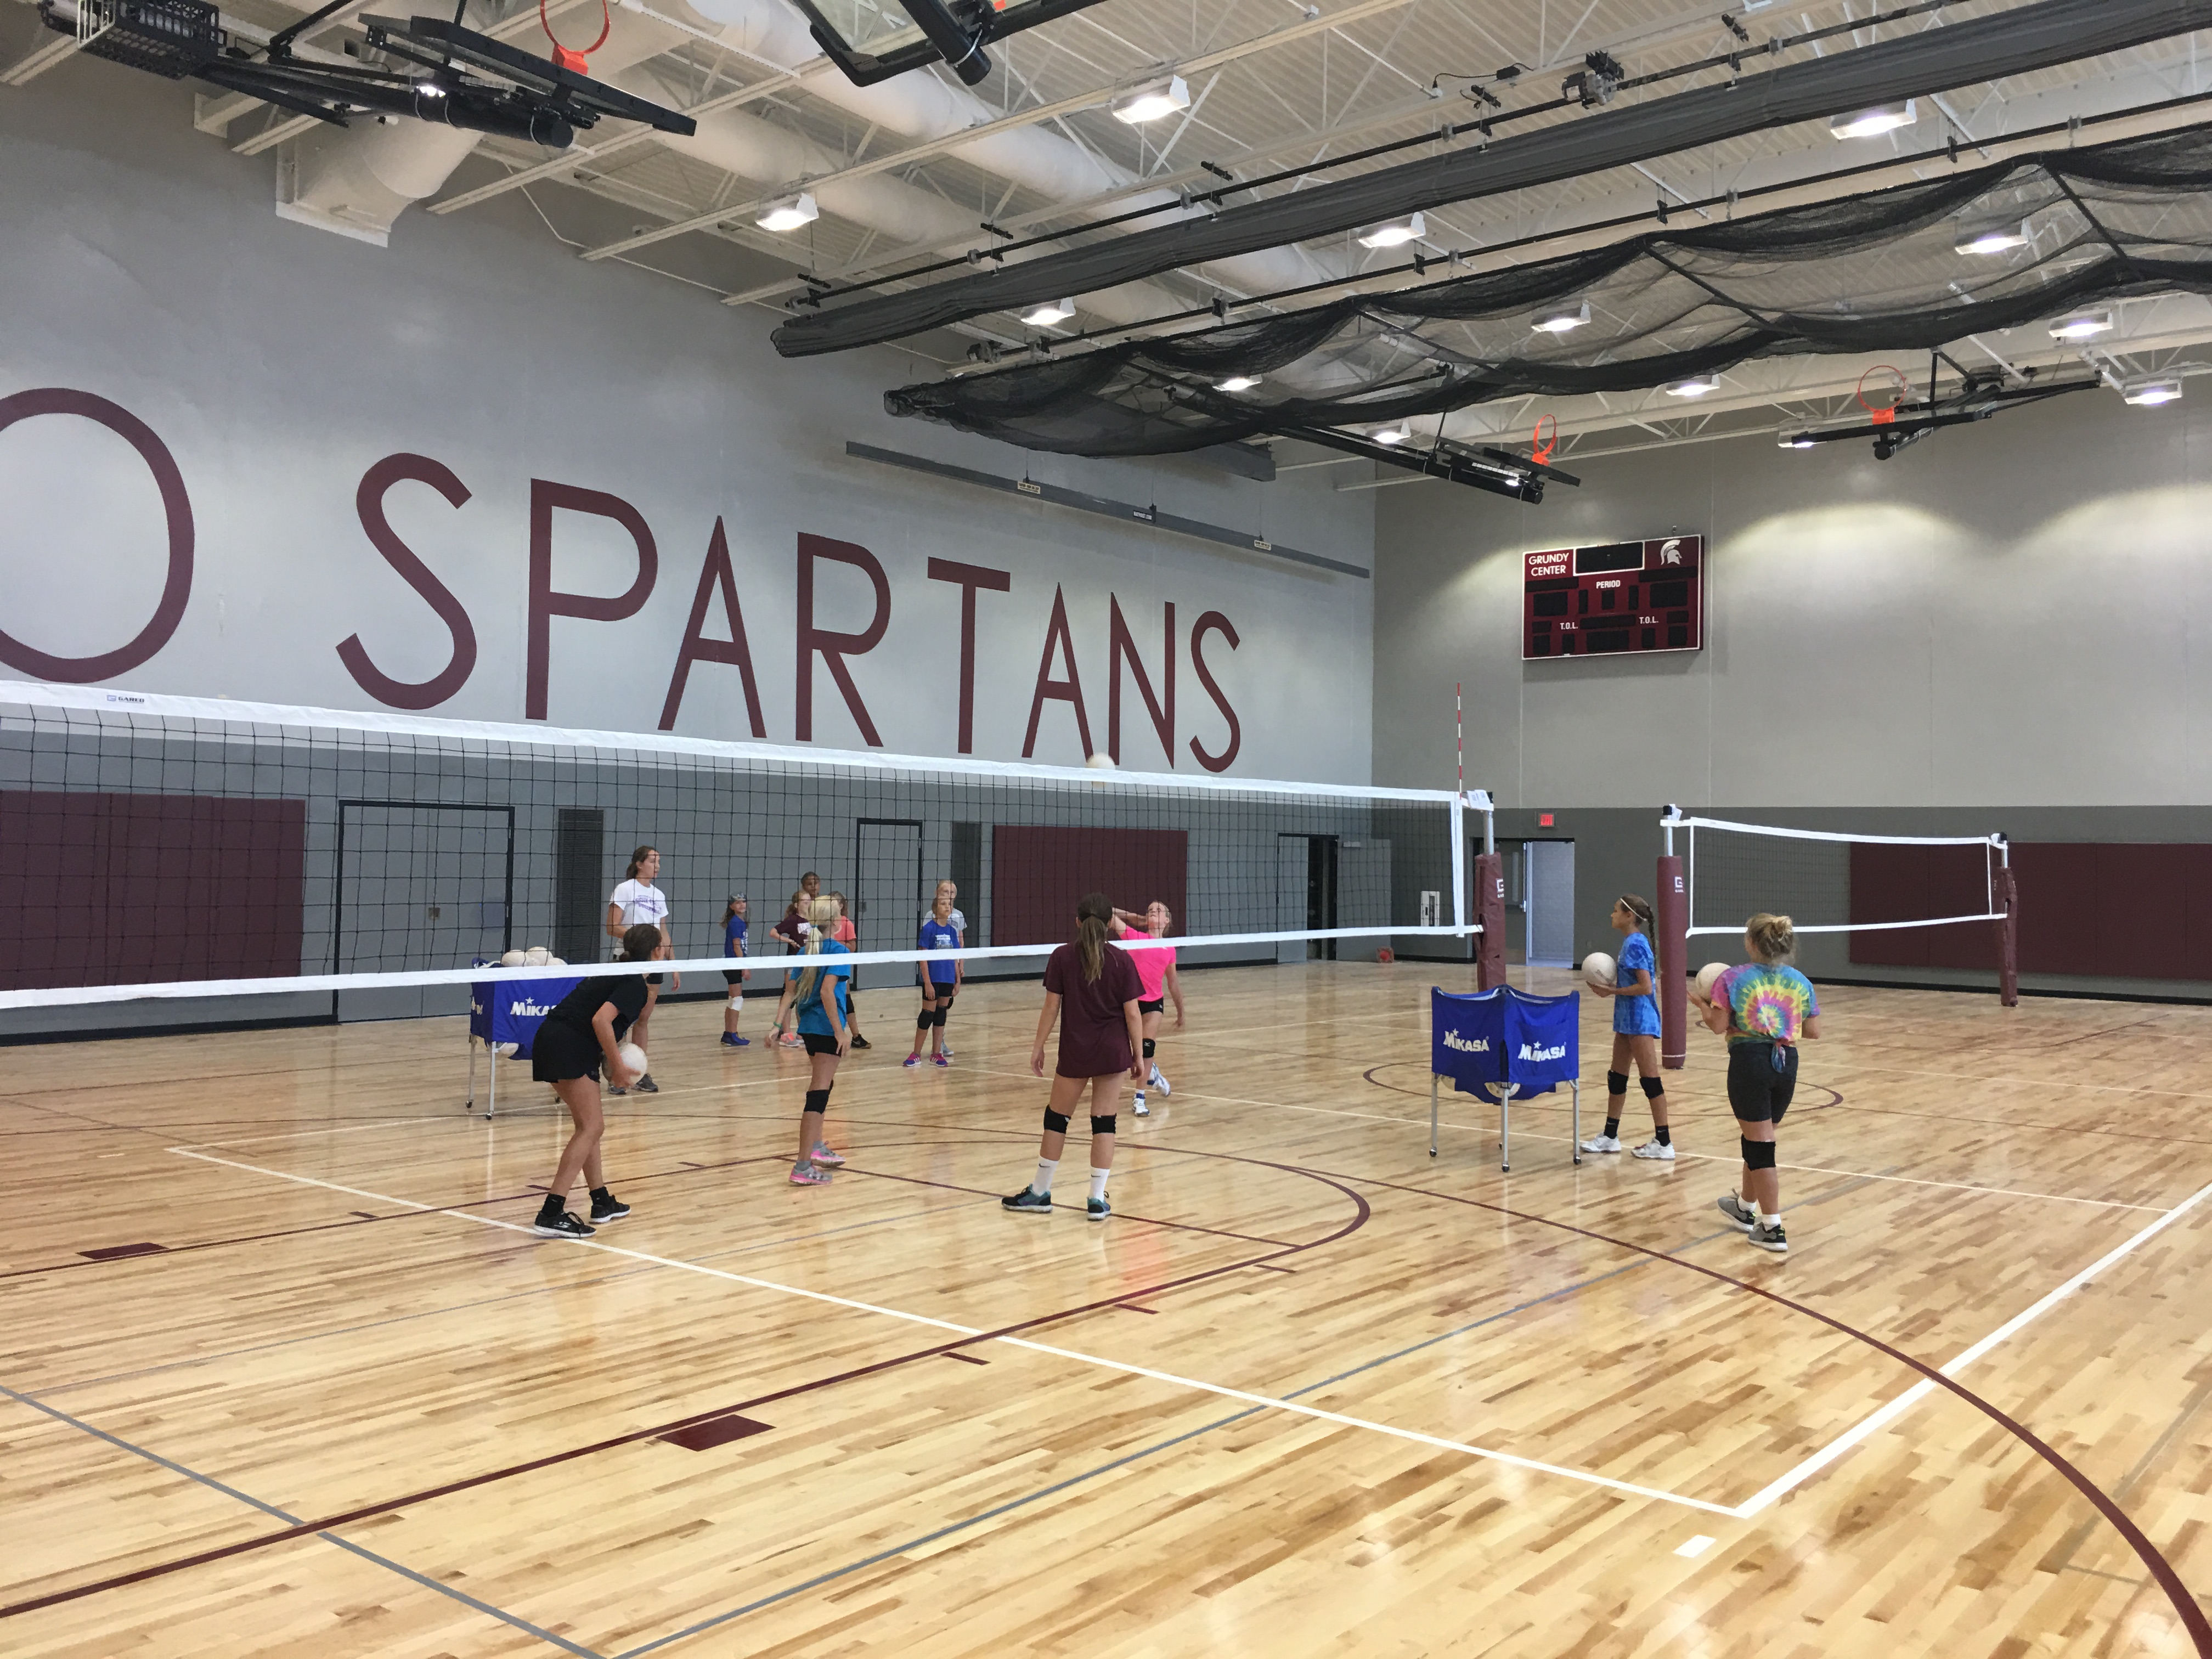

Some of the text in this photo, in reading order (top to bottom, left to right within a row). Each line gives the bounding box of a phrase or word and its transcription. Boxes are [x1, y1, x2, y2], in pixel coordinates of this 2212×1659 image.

[1528, 552, 1570, 565] GRUNDY
[1531, 565, 1566, 577] CENTER
[1596, 580, 1621, 589] PERIOD
[335, 452, 1240, 772] SPARTANS
[1560, 622, 1578, 630] T.O.L.
[1639, 616, 1658, 624] T.O.L.
[510, 996, 557, 1017] MIKA
